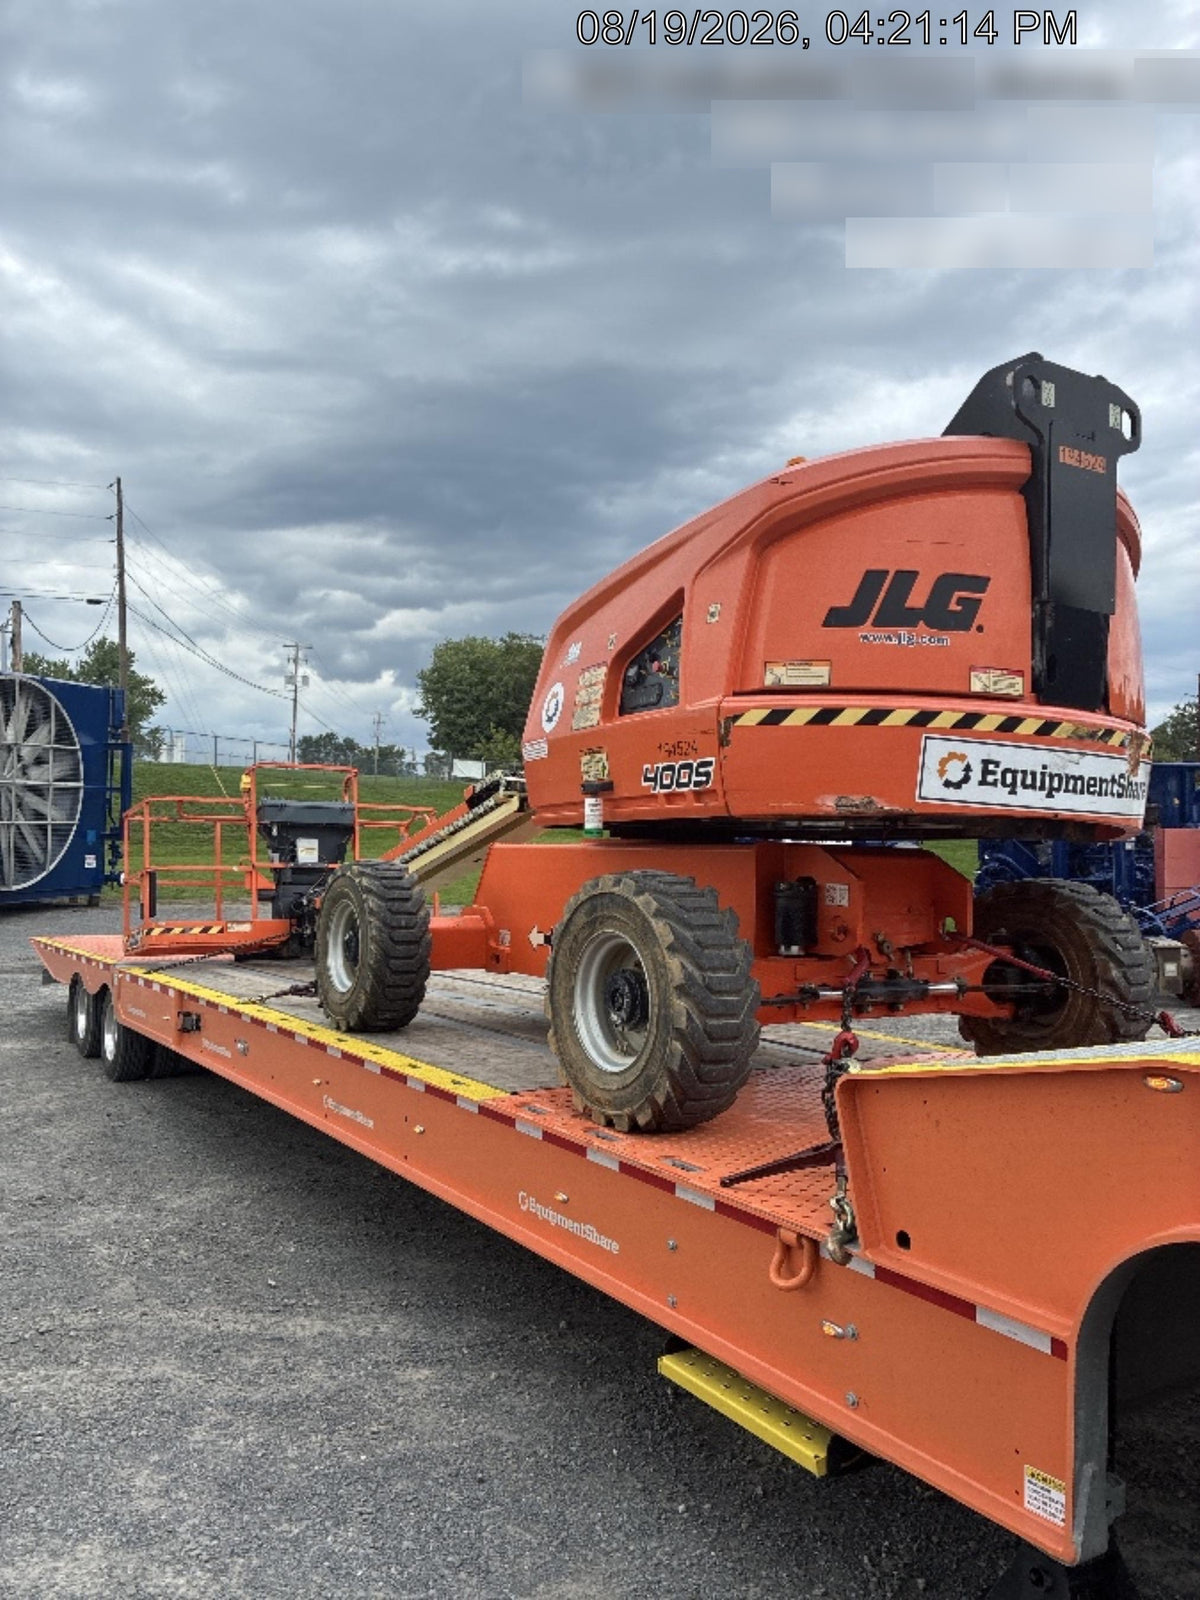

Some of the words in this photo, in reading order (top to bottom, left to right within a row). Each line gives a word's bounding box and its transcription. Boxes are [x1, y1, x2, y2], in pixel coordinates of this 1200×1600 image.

[822, 569, 991, 632] JLG
[858, 631, 951, 648] www.jlg.com
[642, 757, 716, 794] 400S
[529, 1196, 620, 1255] EquipmentShare
